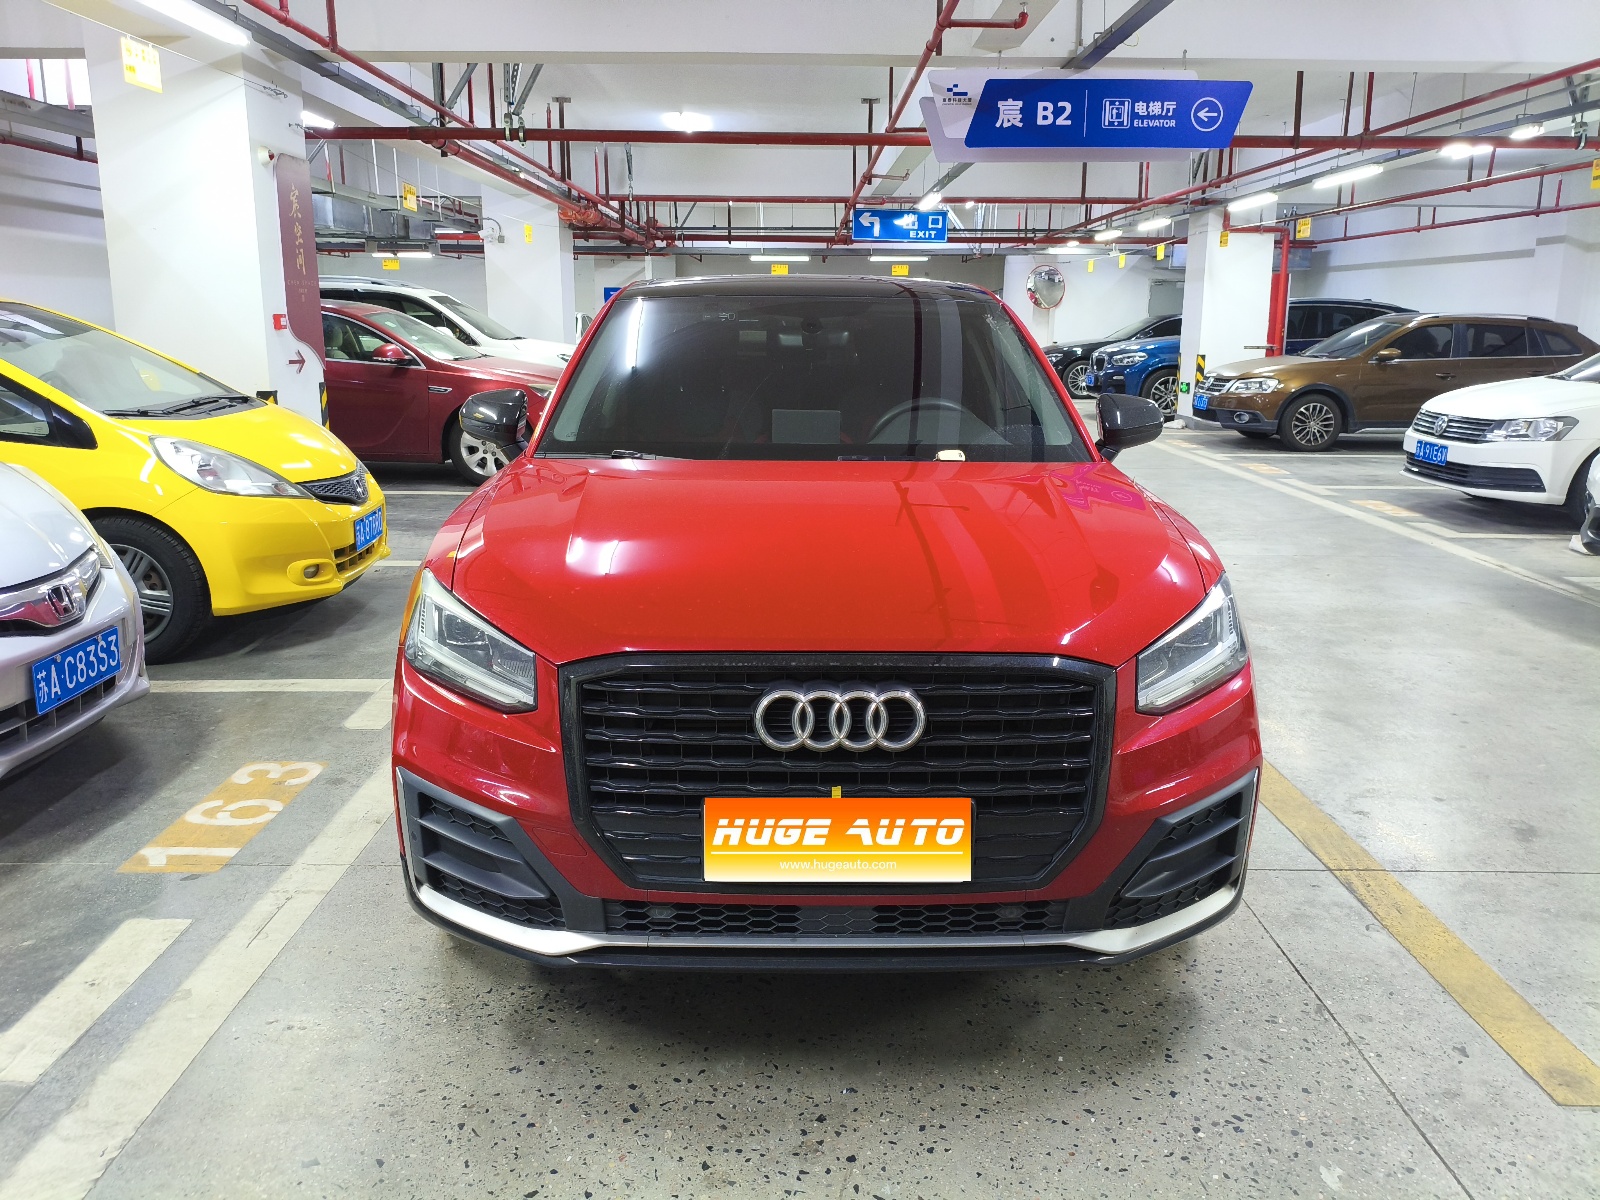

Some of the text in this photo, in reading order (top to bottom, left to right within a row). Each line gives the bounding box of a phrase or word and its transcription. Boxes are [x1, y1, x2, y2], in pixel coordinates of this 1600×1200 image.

[995, 99, 1072, 128] 宸 B2
[1134, 101, 1177, 117] 电梯厅
[1133, 119, 1176, 128] ELEVATOR
[902, 213, 943, 230] 出口
[909, 230, 937, 239] EXIT
[137, 761, 323, 867] 163
